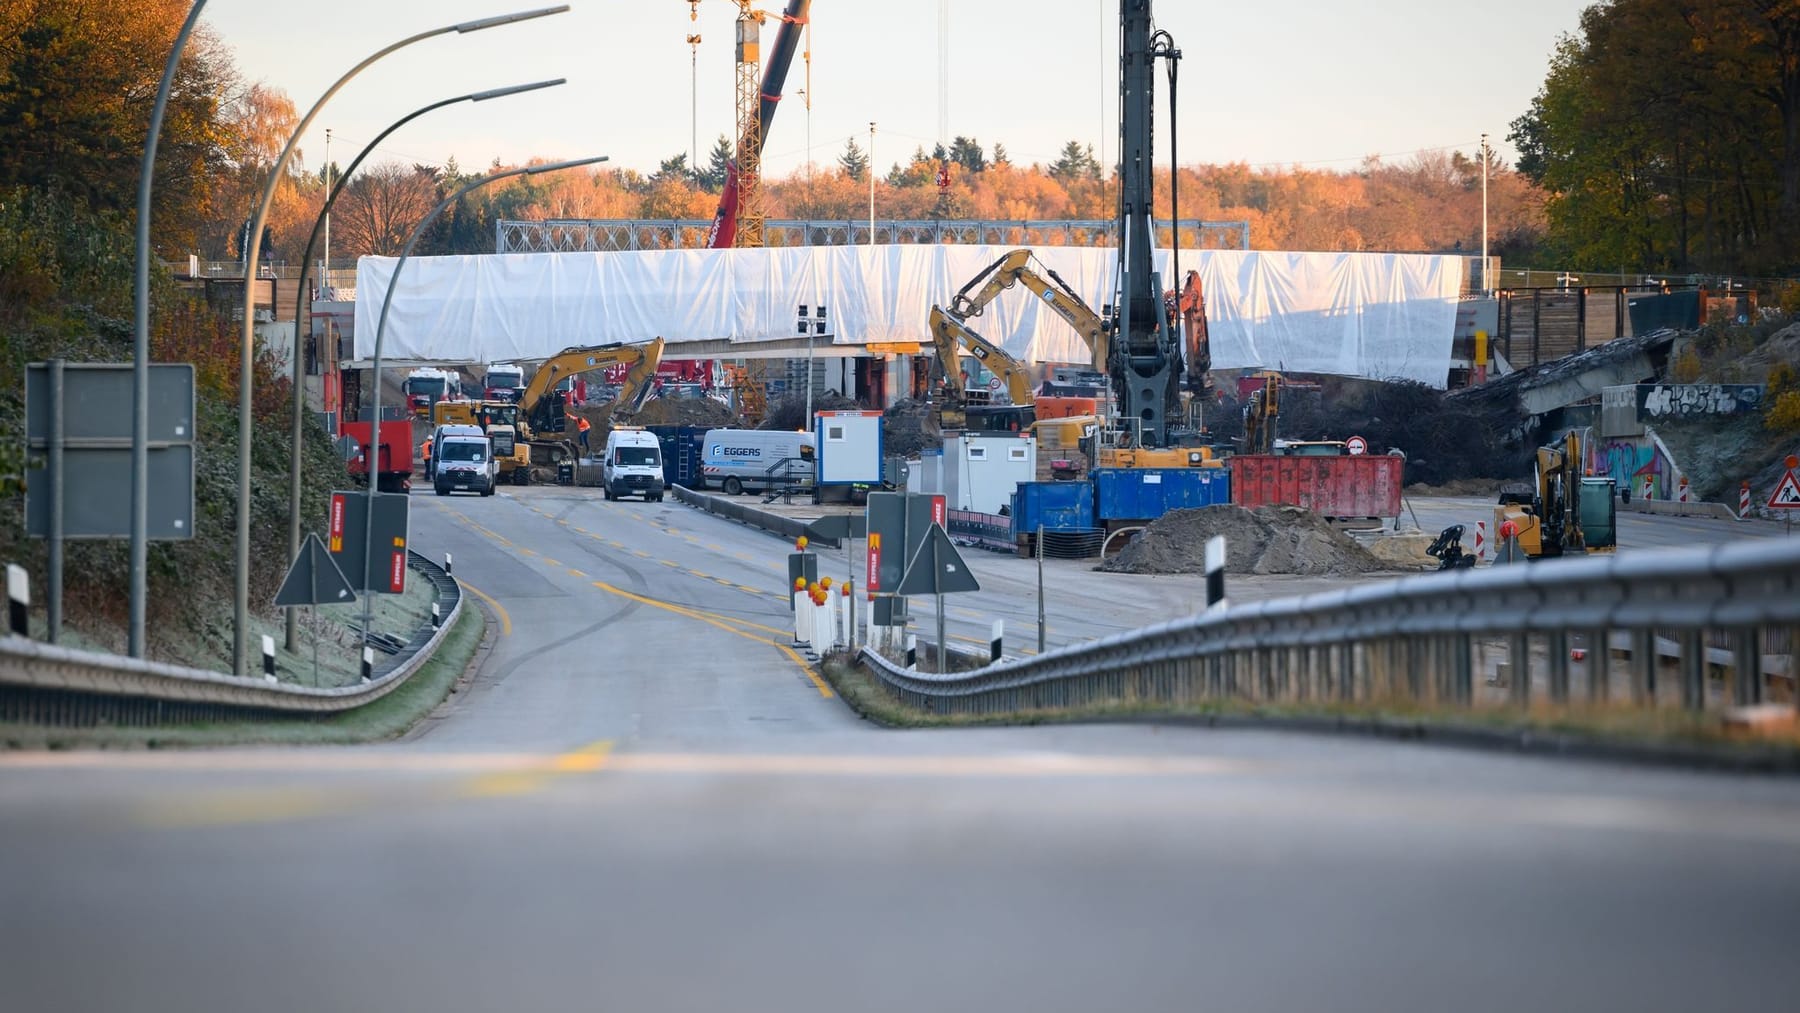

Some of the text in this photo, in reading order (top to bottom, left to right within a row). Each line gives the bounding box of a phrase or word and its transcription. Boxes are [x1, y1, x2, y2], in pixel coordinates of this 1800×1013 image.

[1051, 298, 1075, 322] EGGERS
[974, 346, 986, 358] CAT
[724, 447, 760, 457] EGGERS
